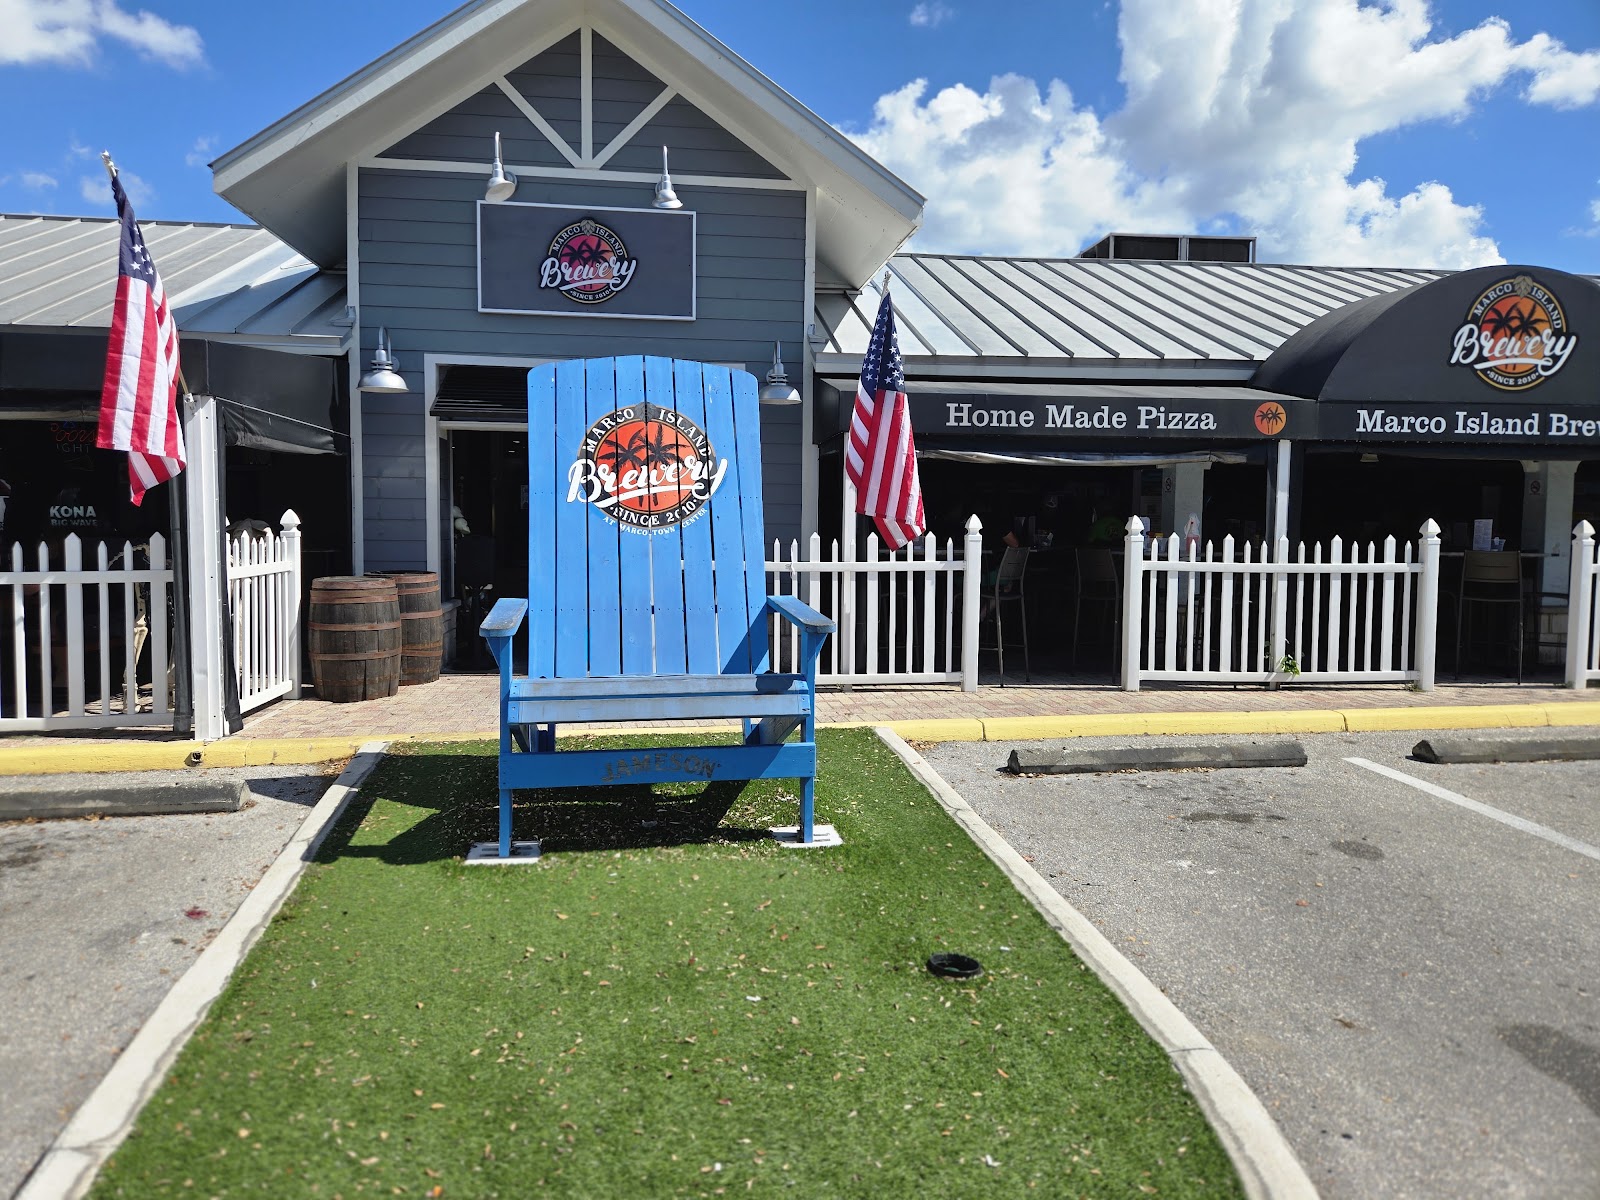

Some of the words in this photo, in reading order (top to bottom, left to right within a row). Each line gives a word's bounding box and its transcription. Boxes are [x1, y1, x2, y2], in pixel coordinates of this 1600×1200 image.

[552, 226, 580, 252] MARCO
[595, 227, 624, 256] ISLAND
[540, 256, 637, 292] Brewery
[572, 291, 593, 300] SINCE
[1473, 283, 1512, 316] MARCO
[1531, 286, 1562, 329] ISLAND
[1450, 323, 1577, 376] Brewery
[1488, 372, 1515, 385] SINCE
[1517, 373, 1537, 385] 2010
[945, 403, 1035, 428] Home
[1044, 404, 1128, 429] Made
[1136, 406, 1217, 430] Pizza
[1355, 409, 1447, 434] Marco
[1454, 411, 1541, 436] Island
[1548, 413, 1600, 437] Bre
[582, 408, 635, 453] MARCO
[658, 409, 712, 456] ISLAND
[566, 455, 728, 508] Brewery
[50, 505, 97, 518] KONA
[603, 516, 616, 526] AT
[620, 523, 648, 535] MARCO
[652, 526, 676, 536] TOWN
[682, 507, 708, 528] CENTER
[613, 507, 660, 525] SINCE
[601, 752, 716, 782] JAMESON
